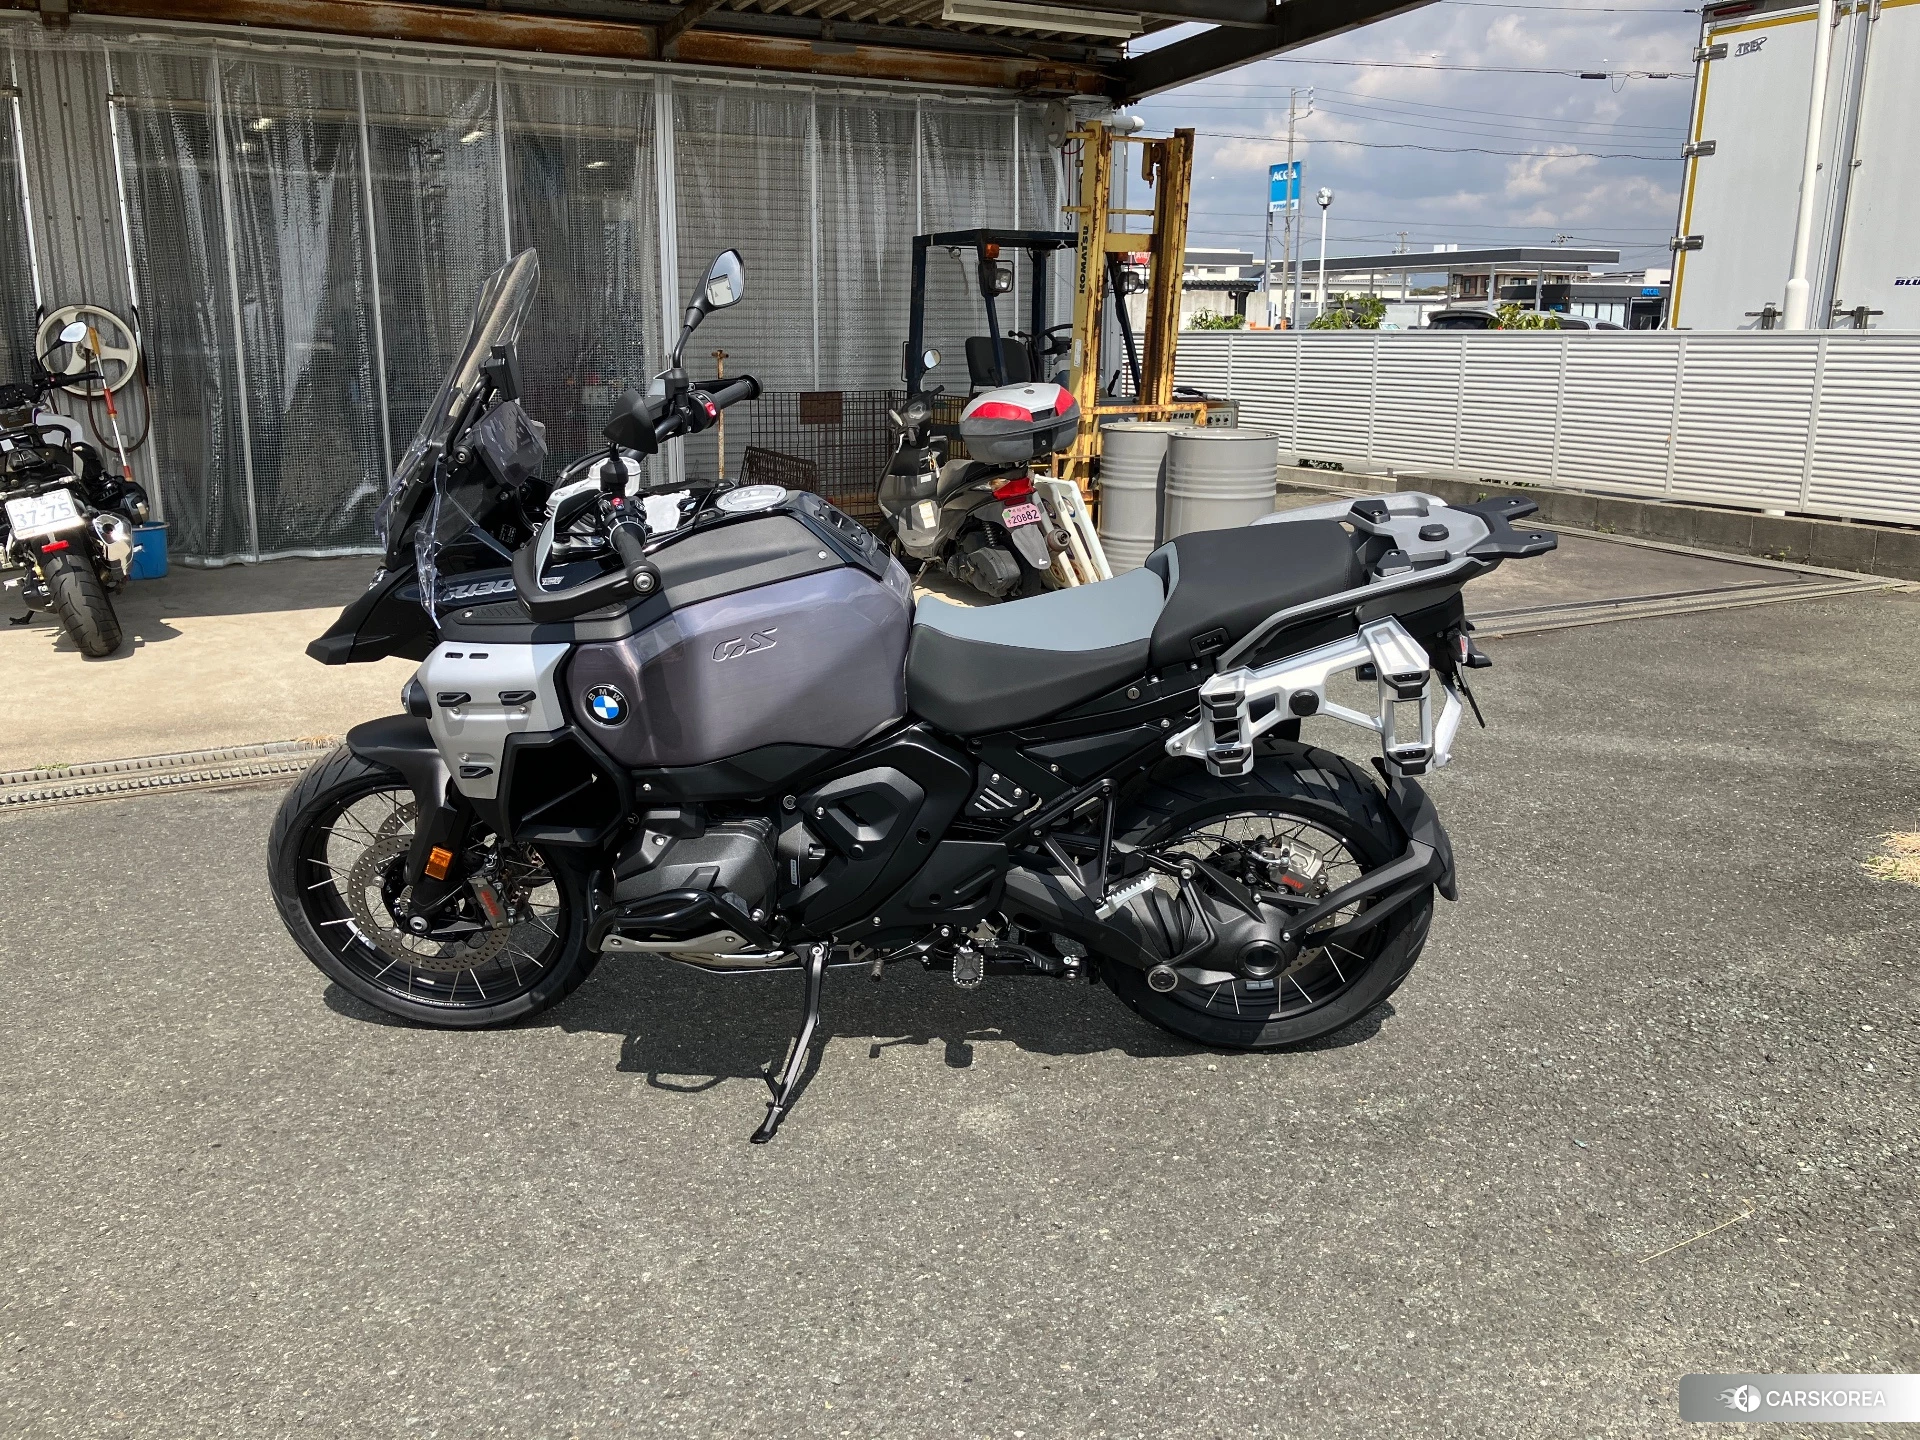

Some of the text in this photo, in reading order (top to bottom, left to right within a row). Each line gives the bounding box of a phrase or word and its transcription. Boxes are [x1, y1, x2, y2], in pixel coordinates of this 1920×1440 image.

[1272, 169, 1298, 182] ACCL
[1079, 226, 1089, 294] KOMATSU
[1641, 287, 1660, 296] ACCEL
[14, 502, 71, 528] 37-75
[1011, 510, 1040, 525] 20882
[443, 578, 517, 602] R130
[711, 626, 778, 663] GS
[586, 688, 623, 702] BMW
